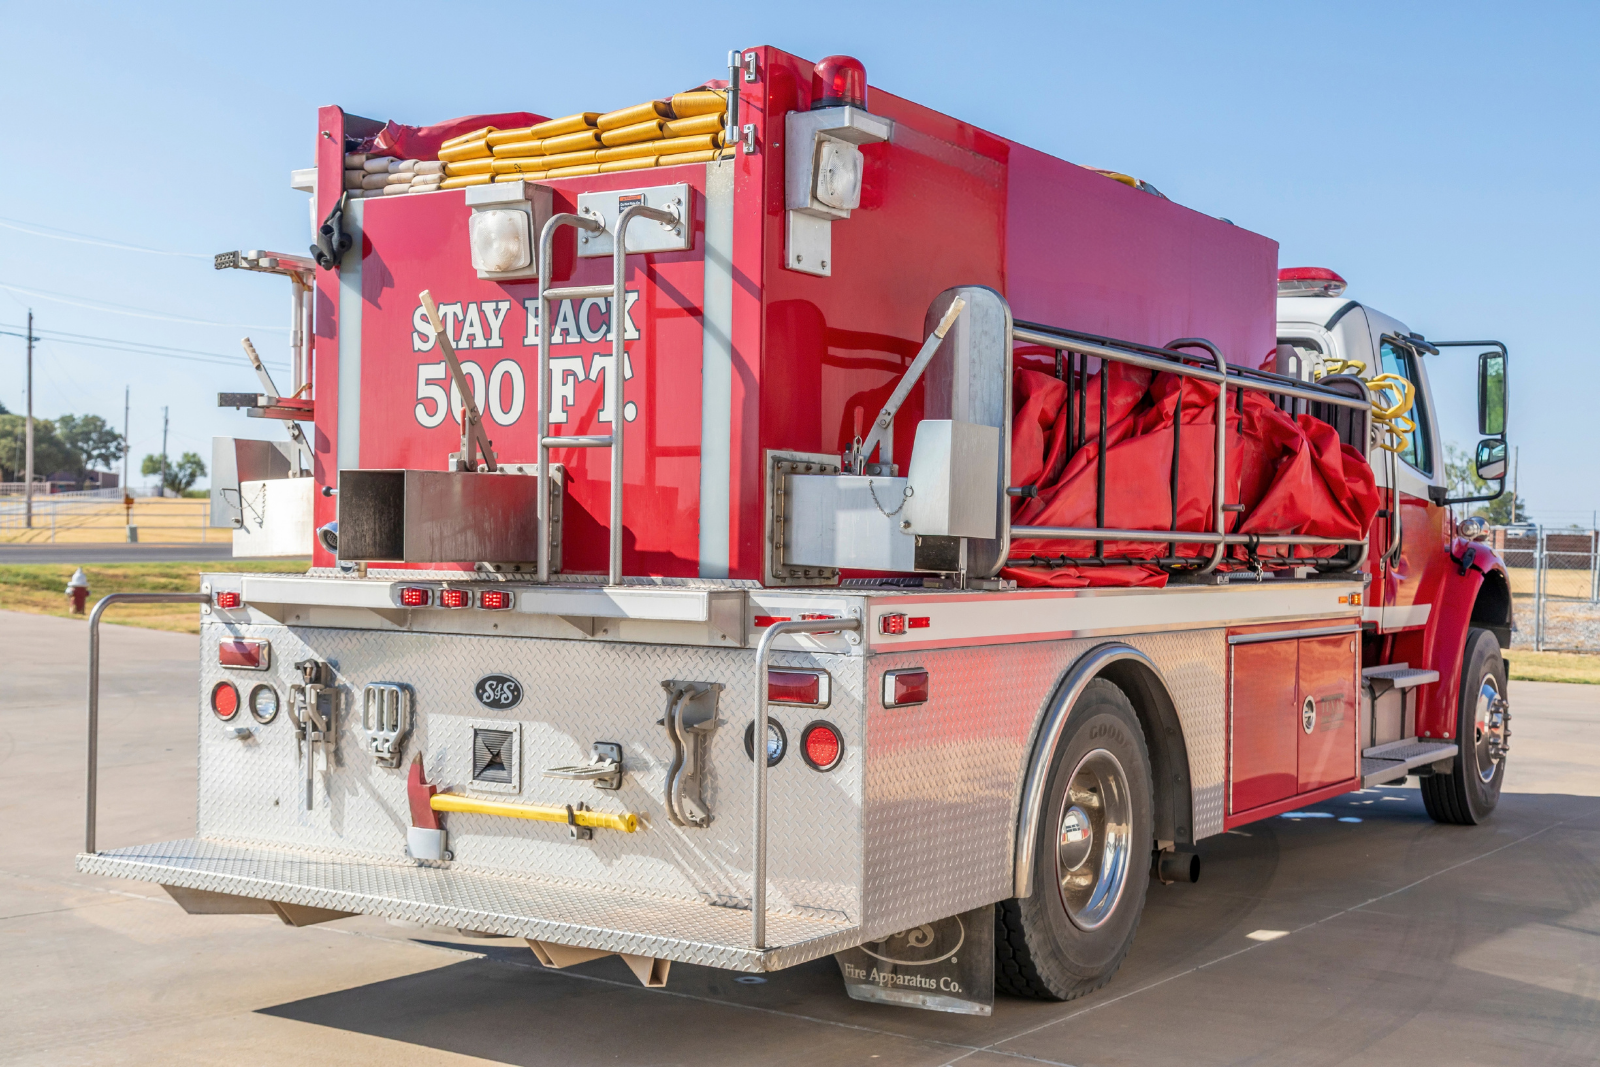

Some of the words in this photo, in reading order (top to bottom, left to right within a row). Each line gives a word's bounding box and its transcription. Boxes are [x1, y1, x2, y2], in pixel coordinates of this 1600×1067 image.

[411, 300, 511, 352] STAY
[414, 358, 526, 429] 500
[548, 351, 638, 424] FT.
[482, 680, 515, 704] S&S
[844, 962, 867, 980] Fire
[869, 967, 937, 990] Apparatus
[939, 976, 963, 993] Co.
